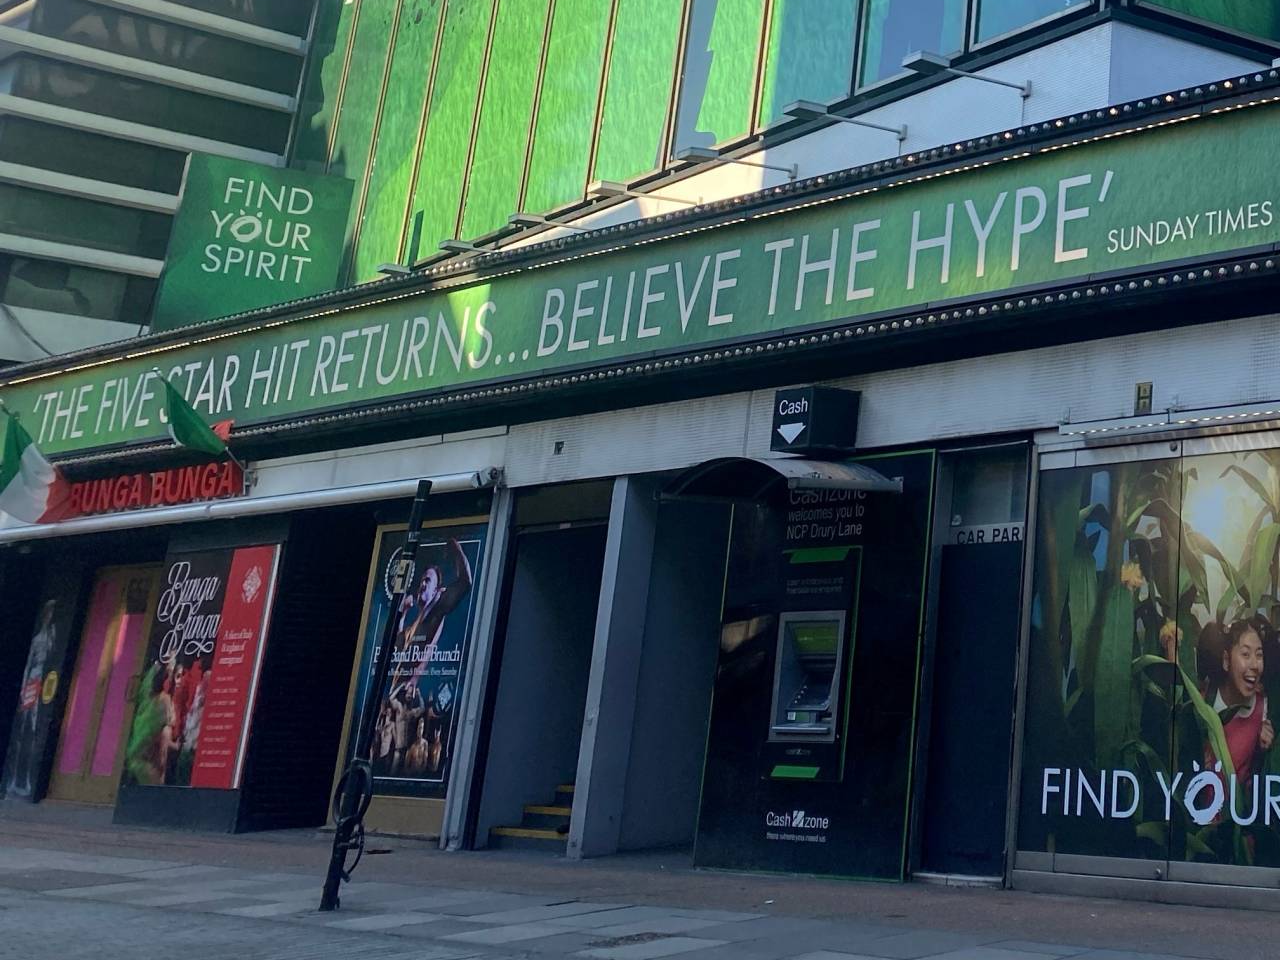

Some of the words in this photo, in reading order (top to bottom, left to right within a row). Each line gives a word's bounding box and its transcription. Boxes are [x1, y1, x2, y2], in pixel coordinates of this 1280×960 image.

[224, 177, 314, 216] FIND
[1107, 214, 1200, 254] SUNDAY
[1206, 201, 1274, 232] TIMES
[201, 243, 312, 284] SPIRIT
[94, 371, 160, 434] FIVE
[245, 339, 310, 408] HIT
[536, 248, 742, 358] BELIEVE
[763, 219, 882, 315] THE
[778, 396, 809, 417] Cash
[150, 461, 233, 505] BUNGA
[786, 524, 808, 540] NCP
[810, 522, 837, 541] Drury
[838, 520, 863, 537] Lane
[788, 508, 833, 522] welcomes
[836, 505, 853, 521] you
[855, 503, 865, 517] to
[957, 529, 985, 545] CAR
[993, 526, 1025, 544] PAR
[157, 561, 221, 622] Bunga
[159, 601, 223, 663] Bunga
[430, 643, 461, 662] Brunch
[1041, 767, 1140, 820] FIND
[766, 810, 791, 828] Cash
[804, 816, 829, 829] zone
